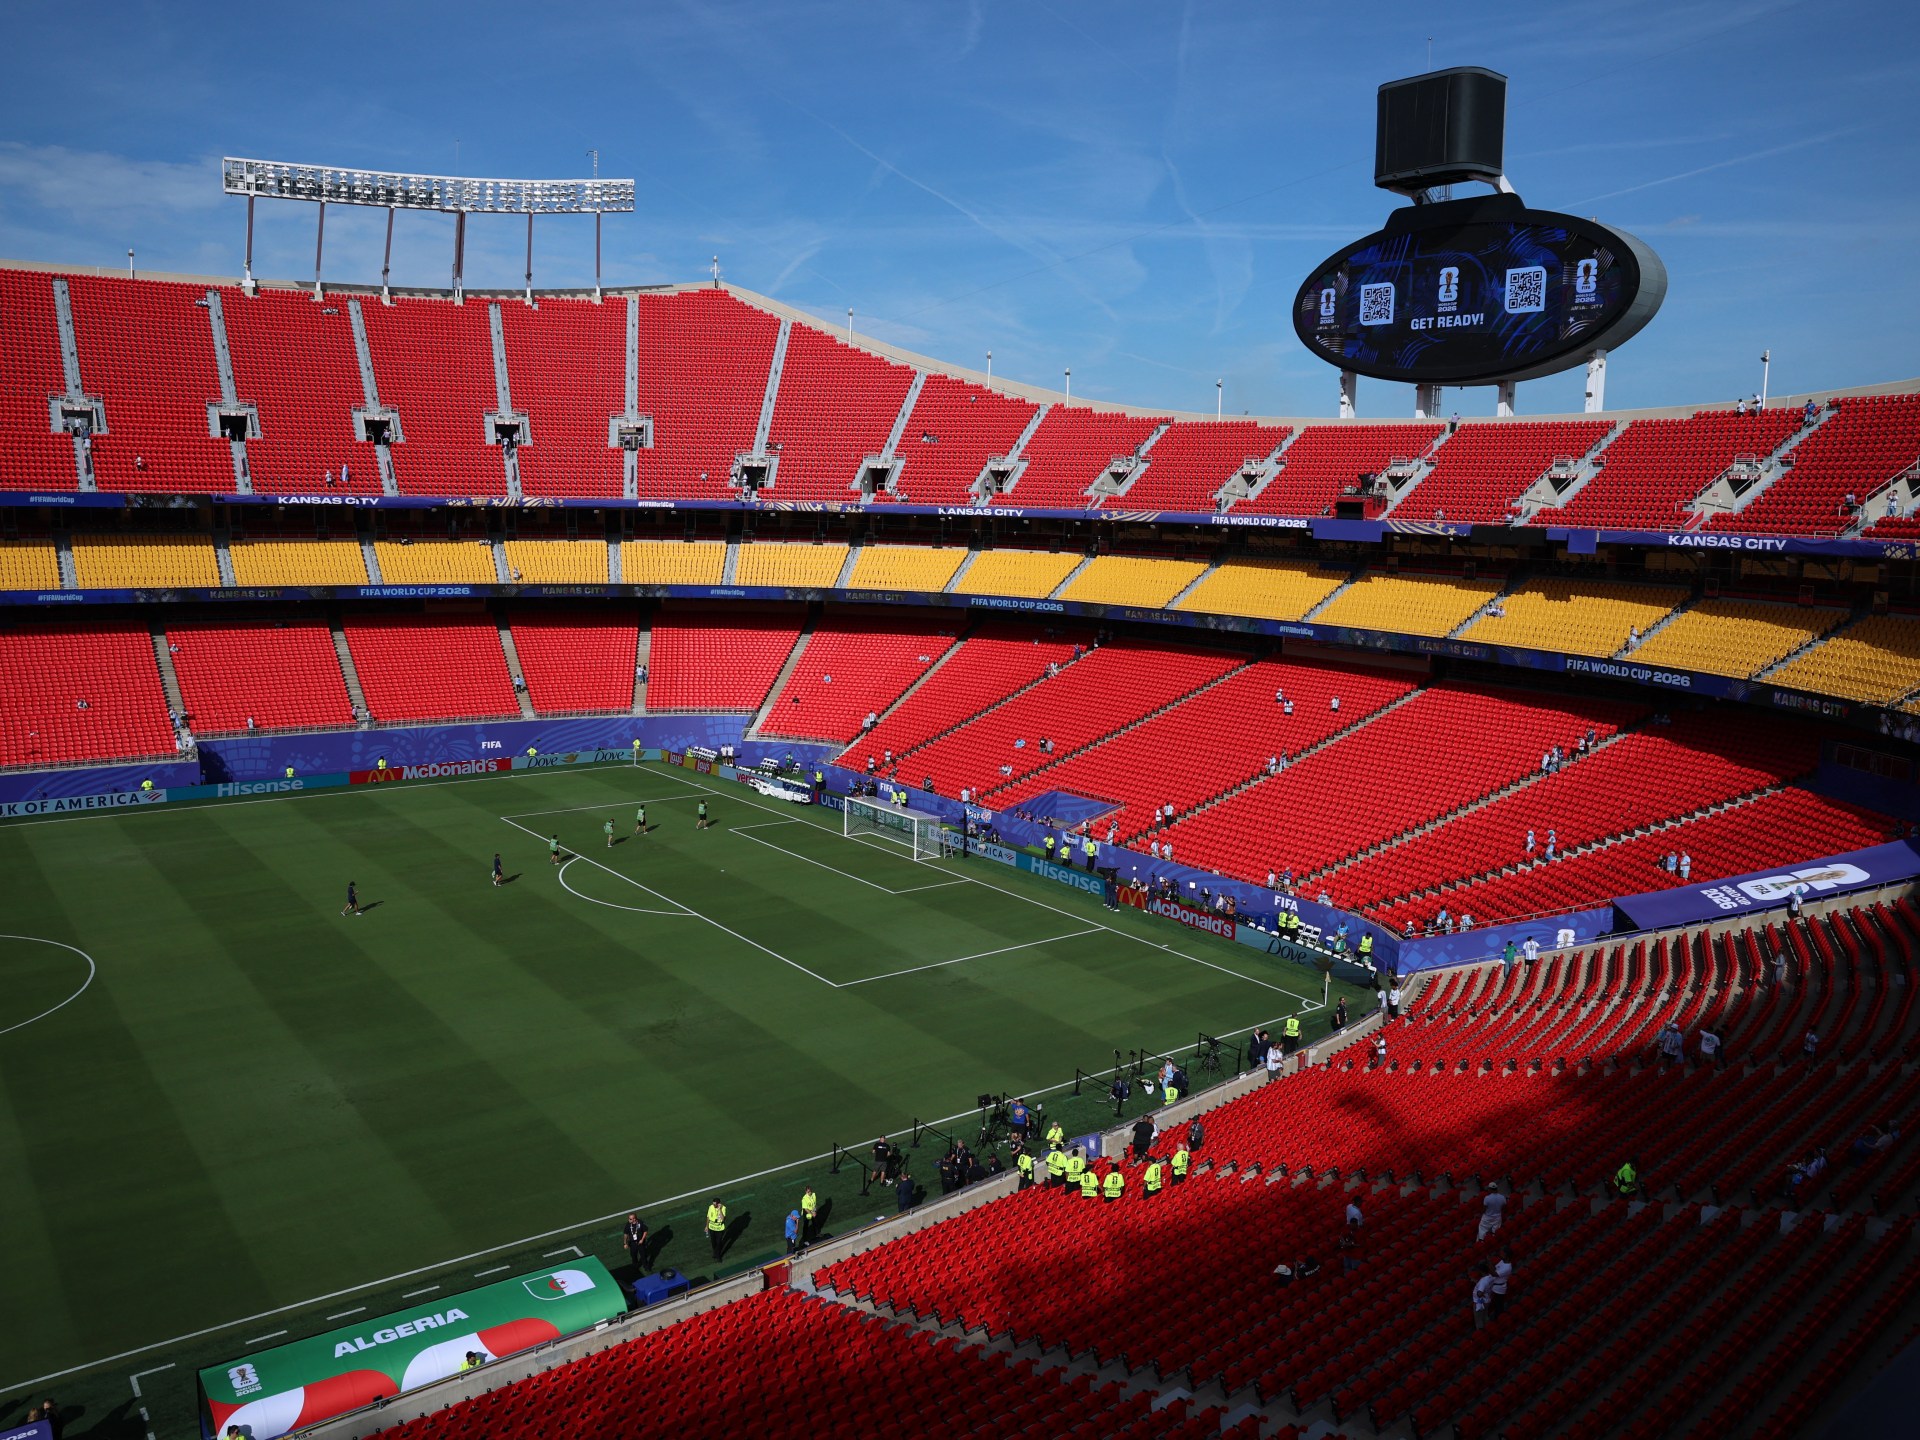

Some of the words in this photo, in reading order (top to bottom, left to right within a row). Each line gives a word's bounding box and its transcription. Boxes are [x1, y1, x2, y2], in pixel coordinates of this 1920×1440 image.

[1410, 317, 1434, 330] GET
[1438, 313, 1484, 328] READY!
[345, 497, 379, 505] CITY
[1212, 516, 1230, 524] FIFA
[1230, 517, 1260, 525] WORLD
[1260, 518, 1278, 526] CUP
[1278, 519, 1308, 528] 2026
[1668, 536, 1741, 548] KANSAS
[1745, 538, 1787, 550] CITY
[38, 593, 83, 602] #FIFAWorldCup
[210, 590, 255, 599] KANSAS
[990, 599, 1018, 608] WORLD
[1020, 601, 1035, 609] CUP
[1036, 602, 1063, 611] 2026
[1566, 659, 1590, 671] FIFA
[1591, 662, 1629, 677] WORLD
[1630, 668, 1652, 680] CUP
[1653, 671, 1690, 686] 2026
[1773, 692, 1820, 712] KANSAS
[482, 740, 502, 749] FIFA
[527, 756, 558, 768] Dove
[594, 750, 624, 763] Dove
[402, 759, 498, 779] McDonald's
[218, 780, 303, 797] Hisense
[880, 782, 893, 793] FIFA
[24, 801, 48, 813] OF
[55, 793, 140, 811] AMERICA
[821, 796, 850, 813] ULTRA
[954, 836, 964, 845] OF
[1031, 857, 1100, 894] Hisense
[1719, 885, 1741, 898] WORLD
[1751, 884, 1771, 896] FIFA
[1274, 895, 1299, 912] FIFA
[1700, 888, 1738, 910] 2026
[1149, 898, 1232, 938] McDonald's
[1265, 937, 1306, 965] Dove
[334, 1308, 470, 1358] ALGERIA
[236, 1386, 262, 1397] 2026
[2, 1429, 38, 1440] 026
